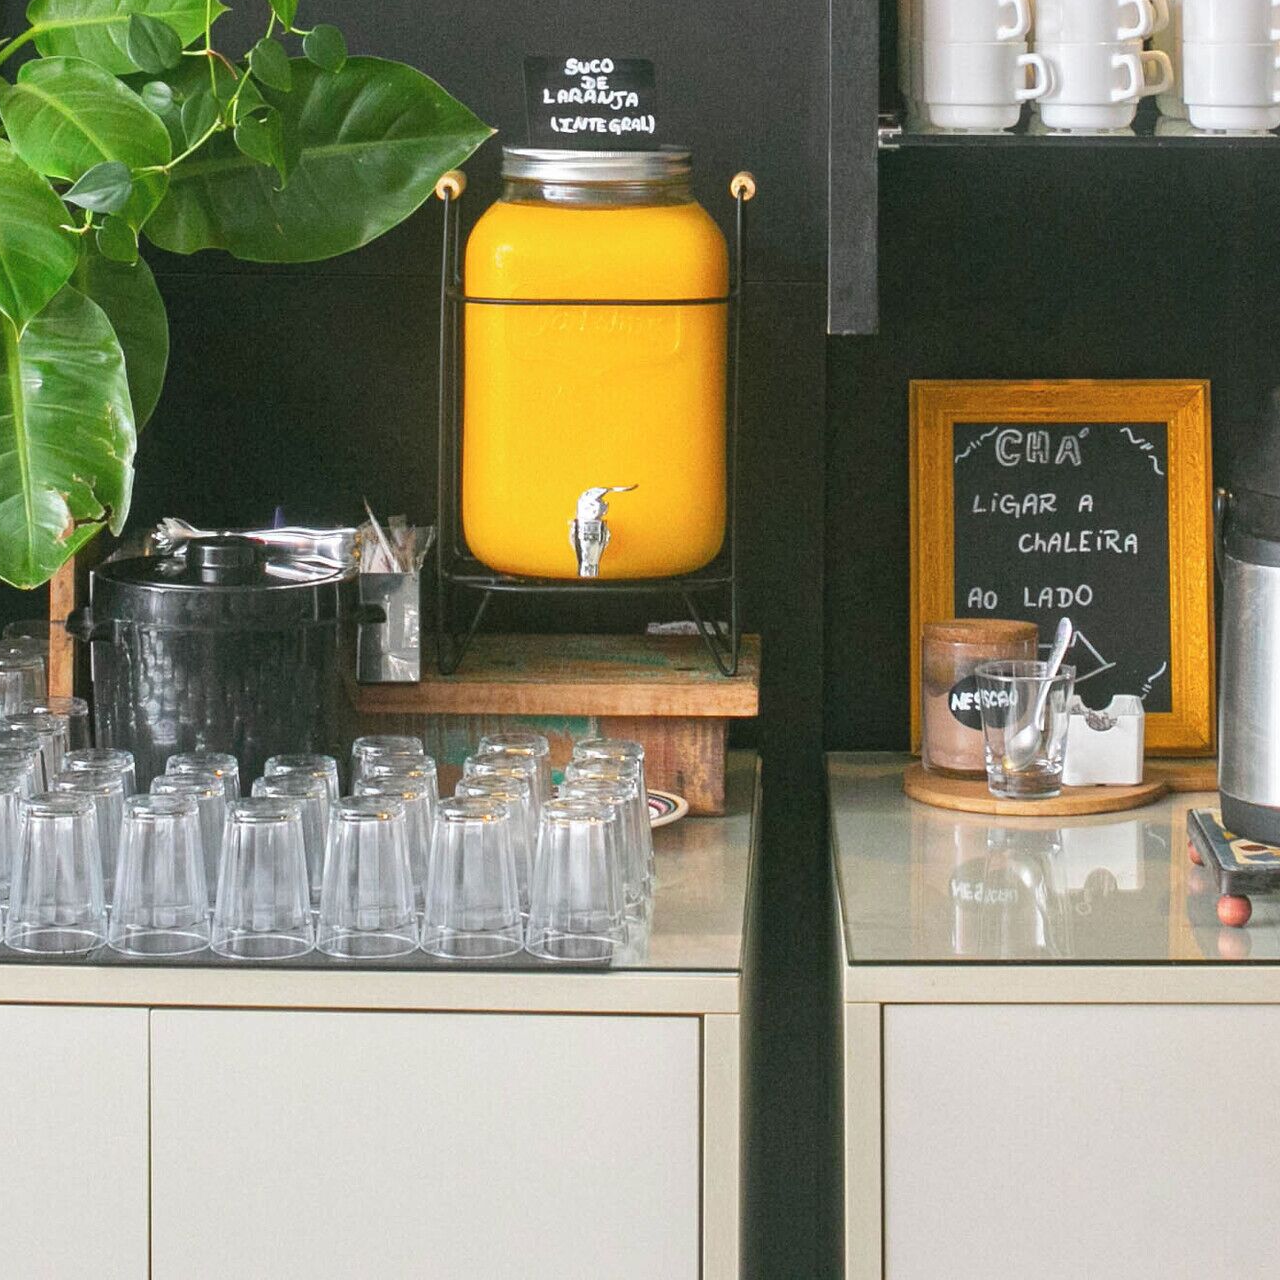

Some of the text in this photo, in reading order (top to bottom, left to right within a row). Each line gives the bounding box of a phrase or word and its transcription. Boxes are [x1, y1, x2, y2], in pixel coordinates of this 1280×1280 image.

[564, 57, 615, 76] SUCO
[580, 75, 610, 90] DE
[543, 88, 639, 110] LARANJA
[550, 114, 656, 135] (INTEGRAL)
[995, 426, 1090, 467] CHÁ
[1077, 493, 1094, 513] A
[967, 584, 1094, 610] AO LADO
